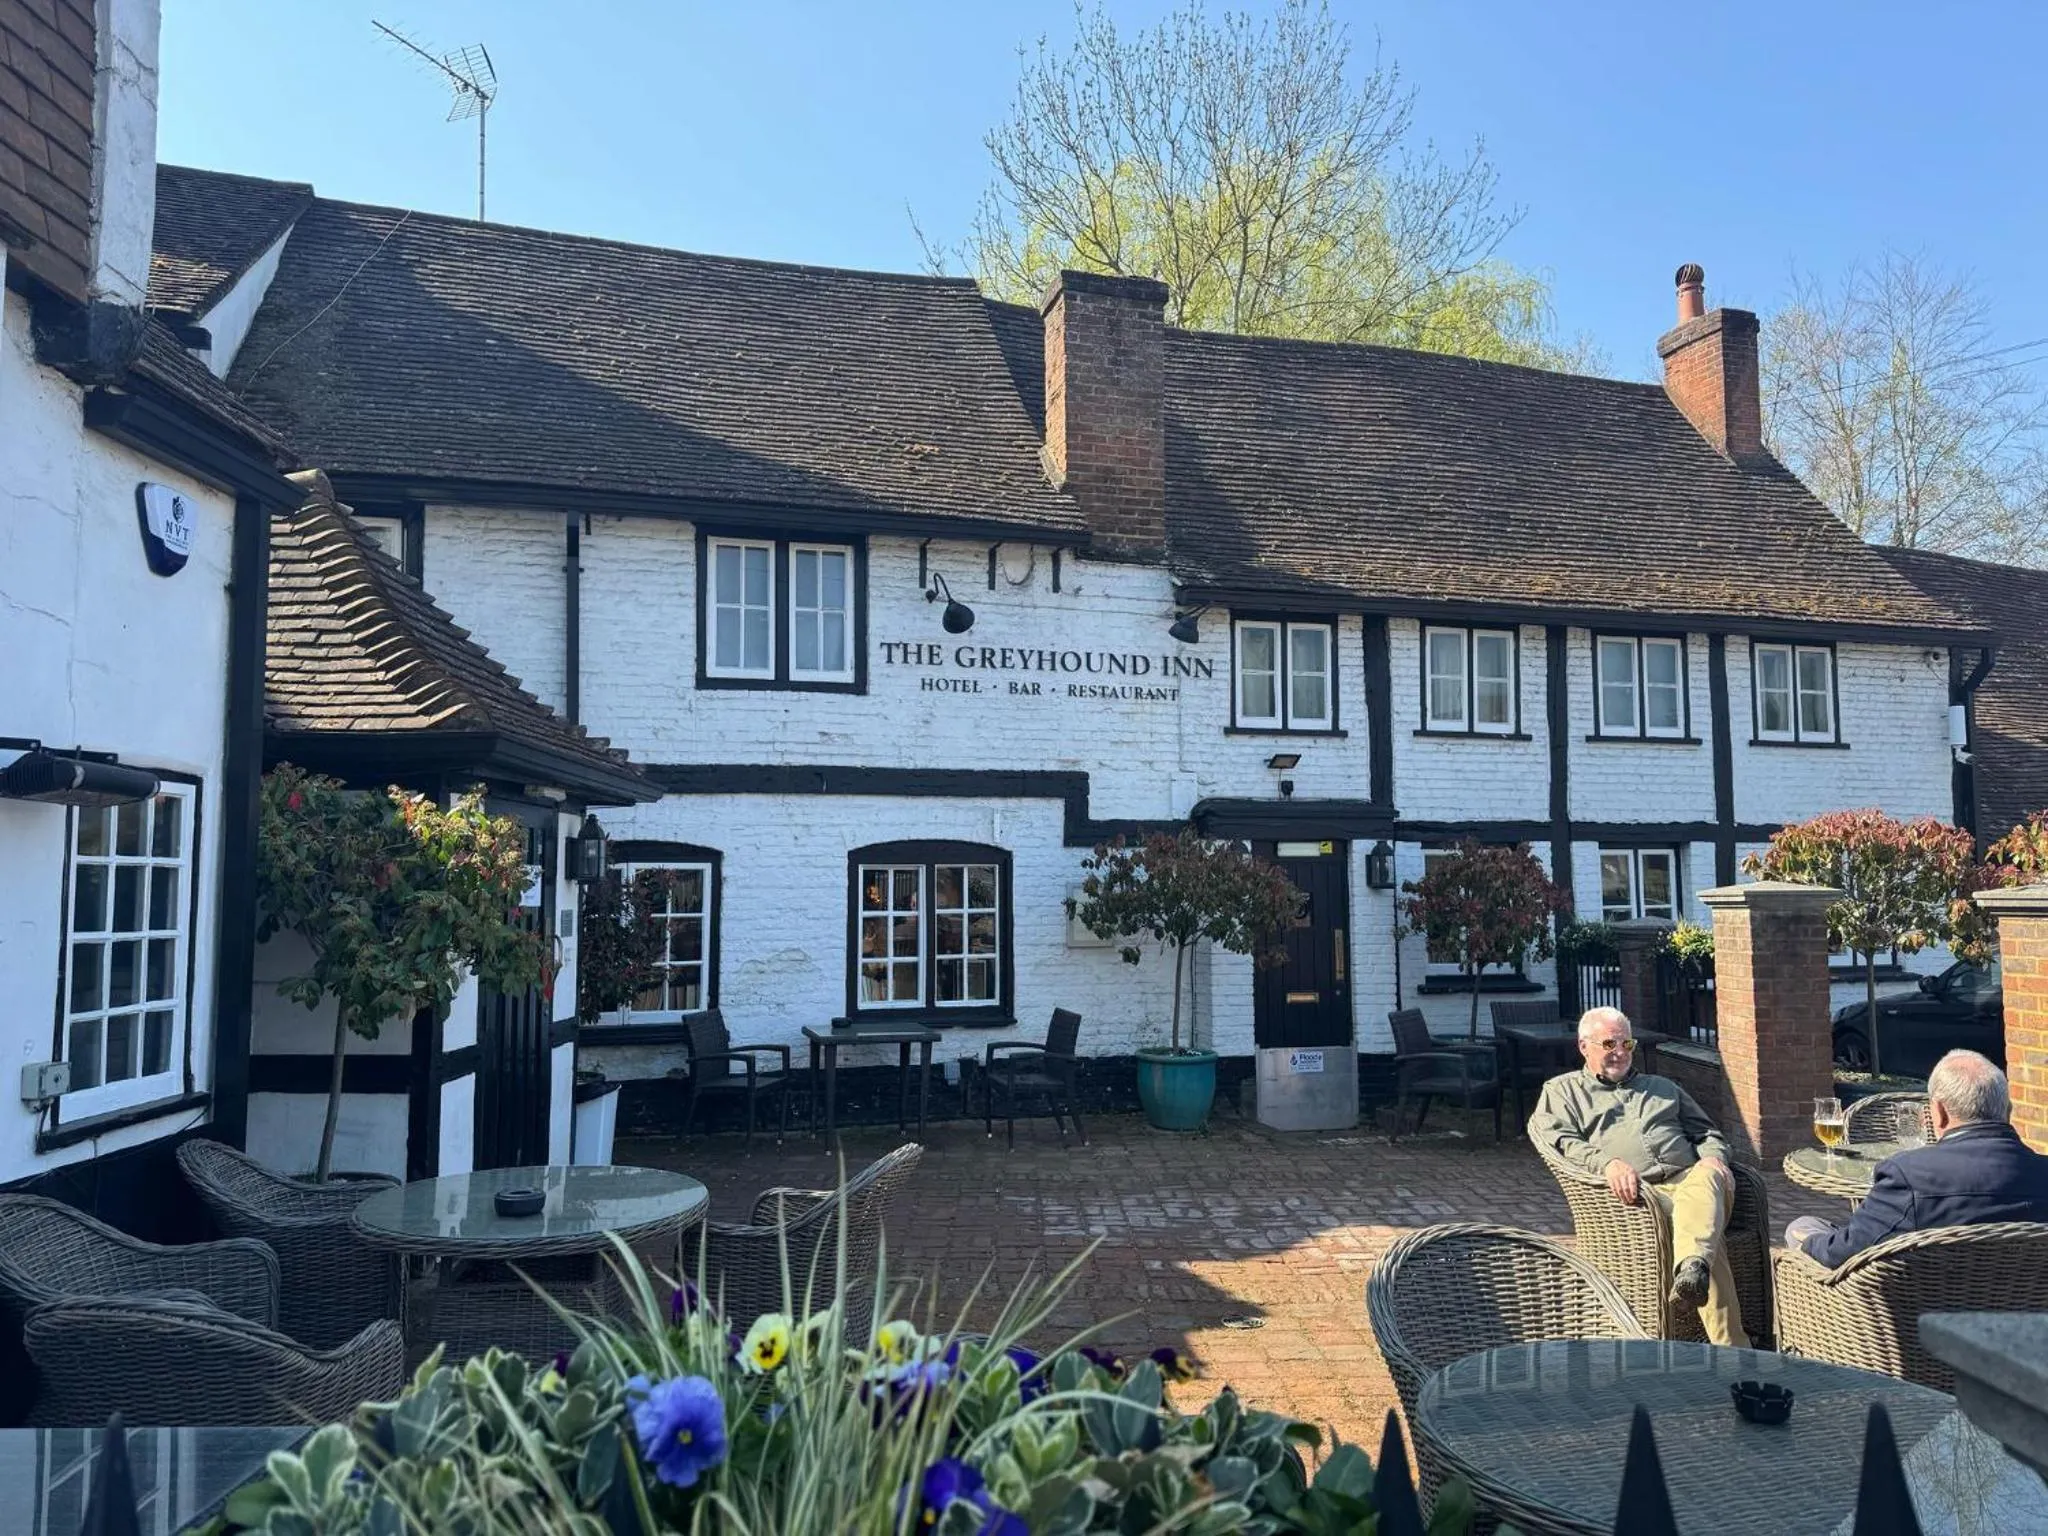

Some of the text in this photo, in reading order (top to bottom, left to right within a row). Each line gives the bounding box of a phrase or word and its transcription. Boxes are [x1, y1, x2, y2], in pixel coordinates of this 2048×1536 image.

[165, 519, 189, 540] NVT
[880, 642, 1213, 679] THE GREYHOUND INN
[921, 678, 1179, 702] HOTEL BAR RESTAURANT
